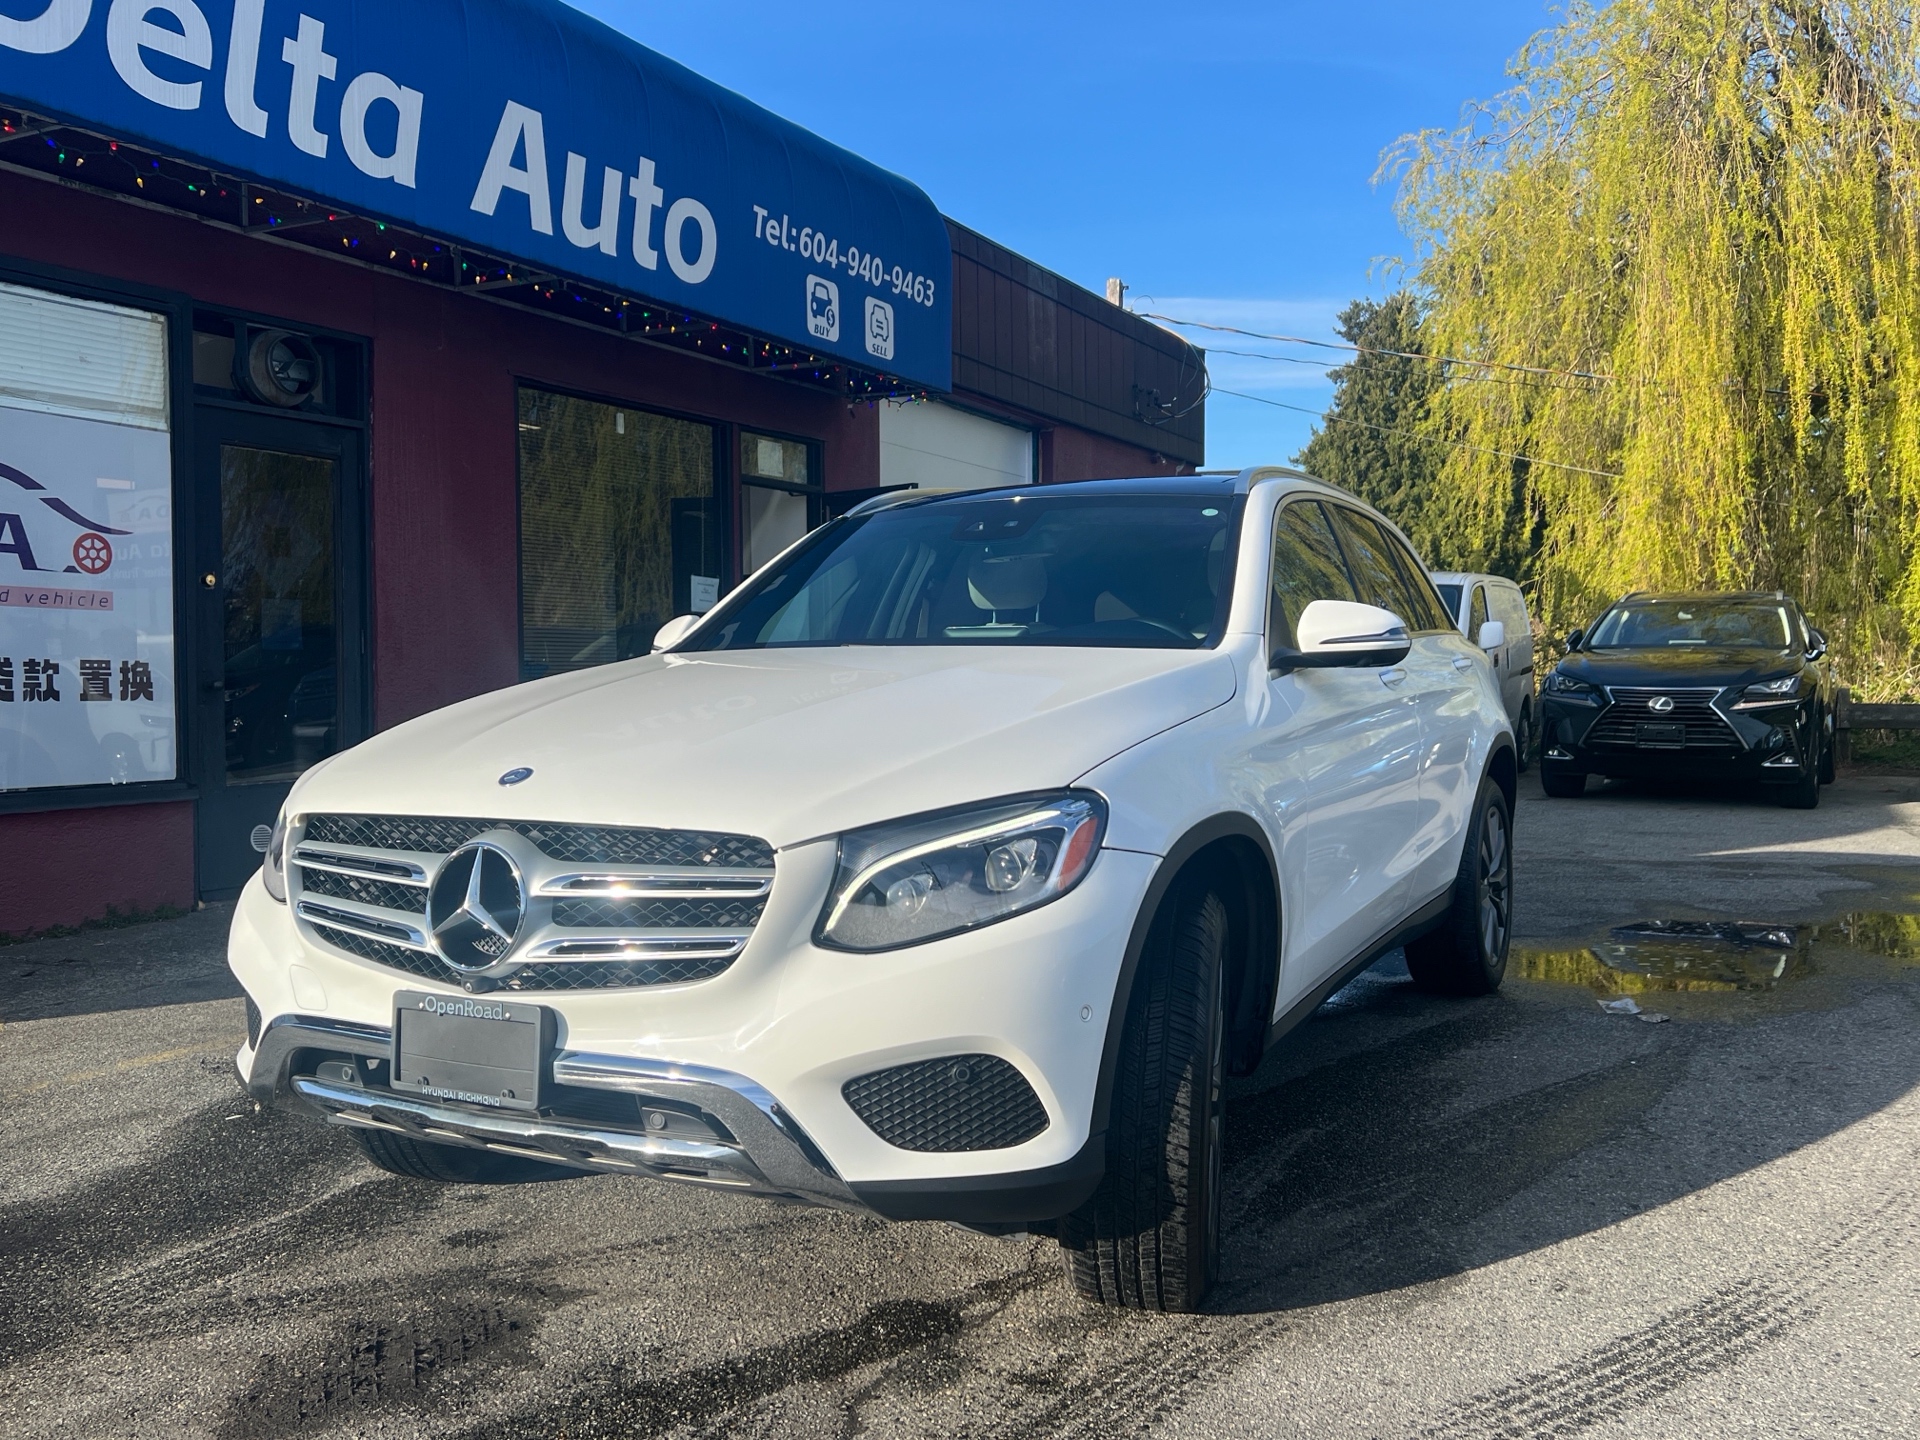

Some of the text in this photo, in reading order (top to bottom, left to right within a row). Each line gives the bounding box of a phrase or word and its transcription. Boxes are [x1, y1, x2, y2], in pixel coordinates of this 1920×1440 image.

[0, 0, 718, 285] elta Auto
[752, 204, 935, 308] Tel:604-940-9463
[813, 323, 831, 338] BUY
[871, 343, 888, 357] SELL
[24, 591, 109, 608] vehicle
[424, 996, 504, 1020] OpenRoad
[422, 1086, 501, 1106] HYUNDAI RICHMOND
